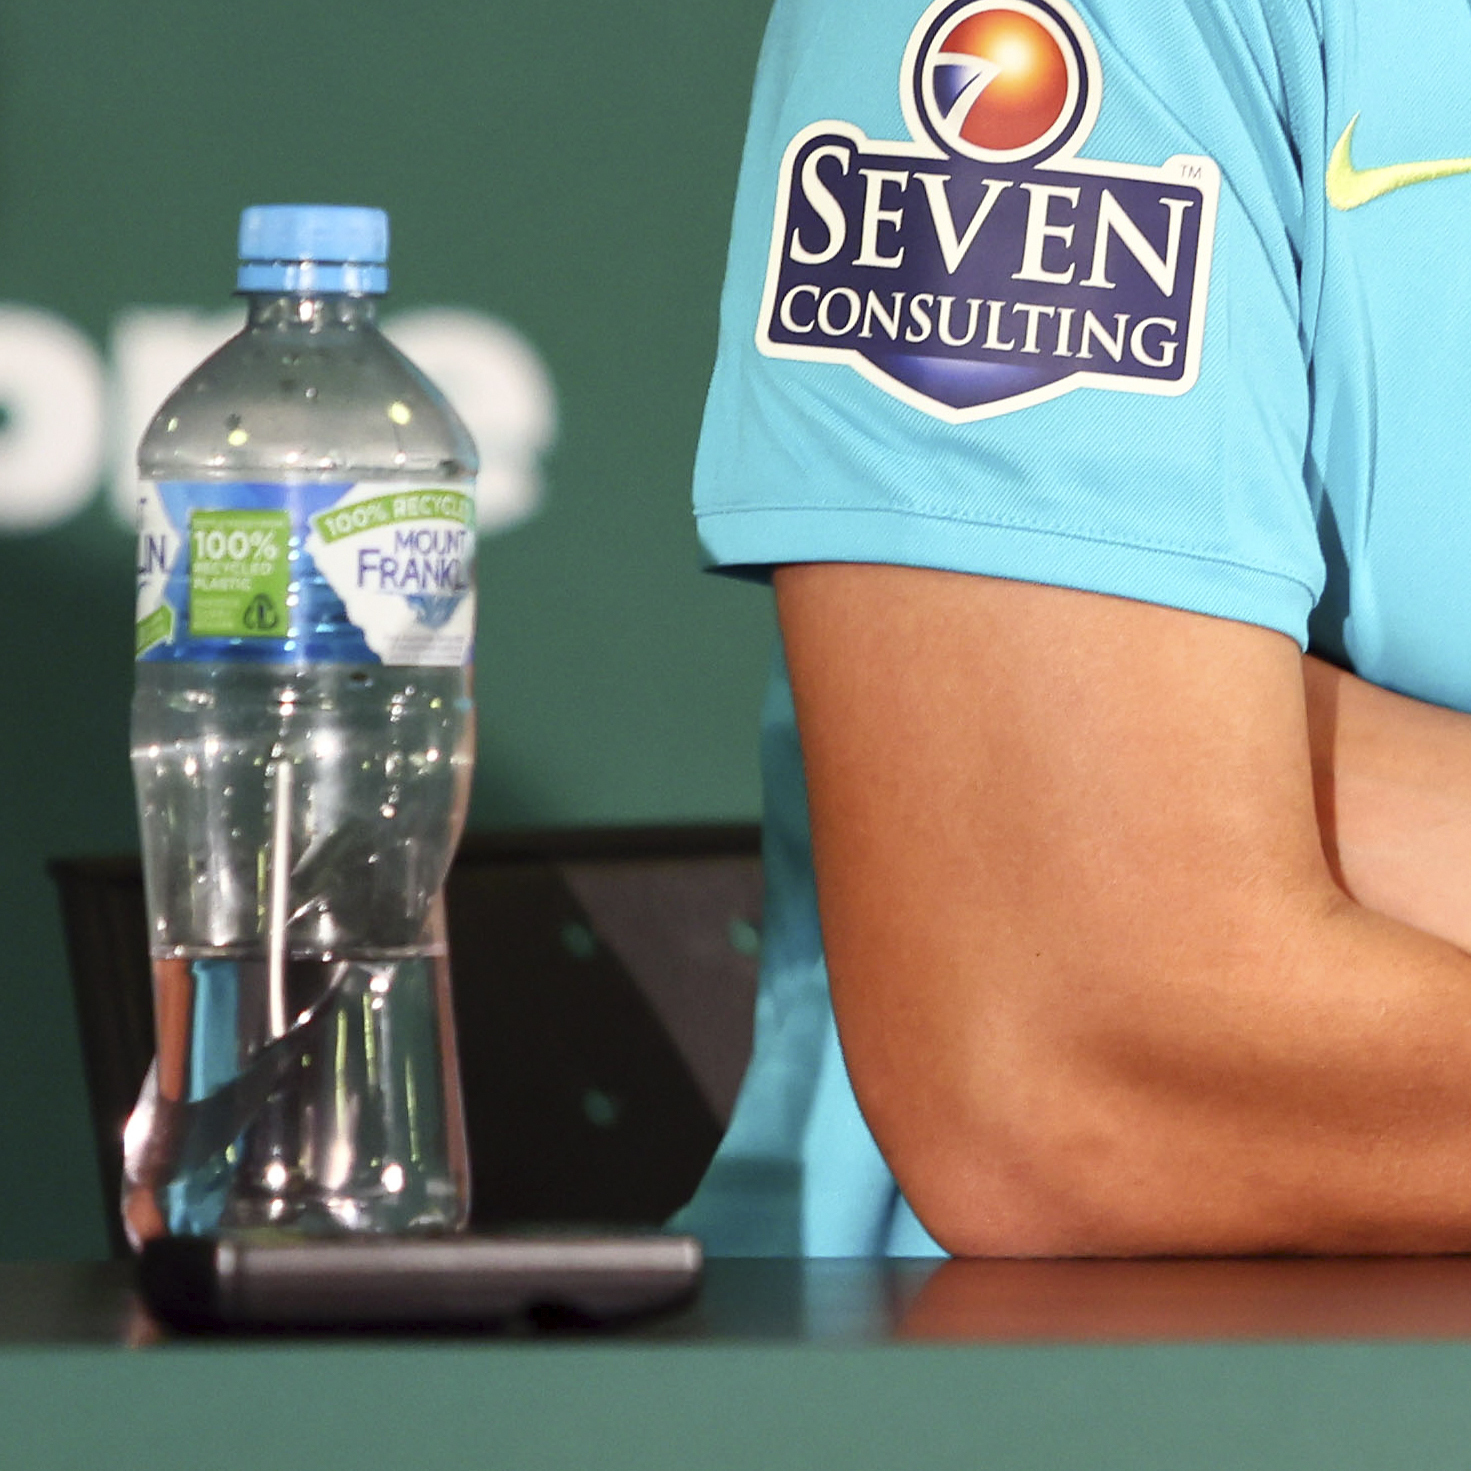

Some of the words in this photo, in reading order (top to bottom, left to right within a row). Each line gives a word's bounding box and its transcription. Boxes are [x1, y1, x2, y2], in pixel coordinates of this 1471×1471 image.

[788, 144, 1195, 299] SEVEN
[779, 284, 1180, 368] CONSULTING
[324, 496, 388, 537] 100%
[194, 530, 279, 561] 100%
[394, 529, 467, 555] MOUNT
